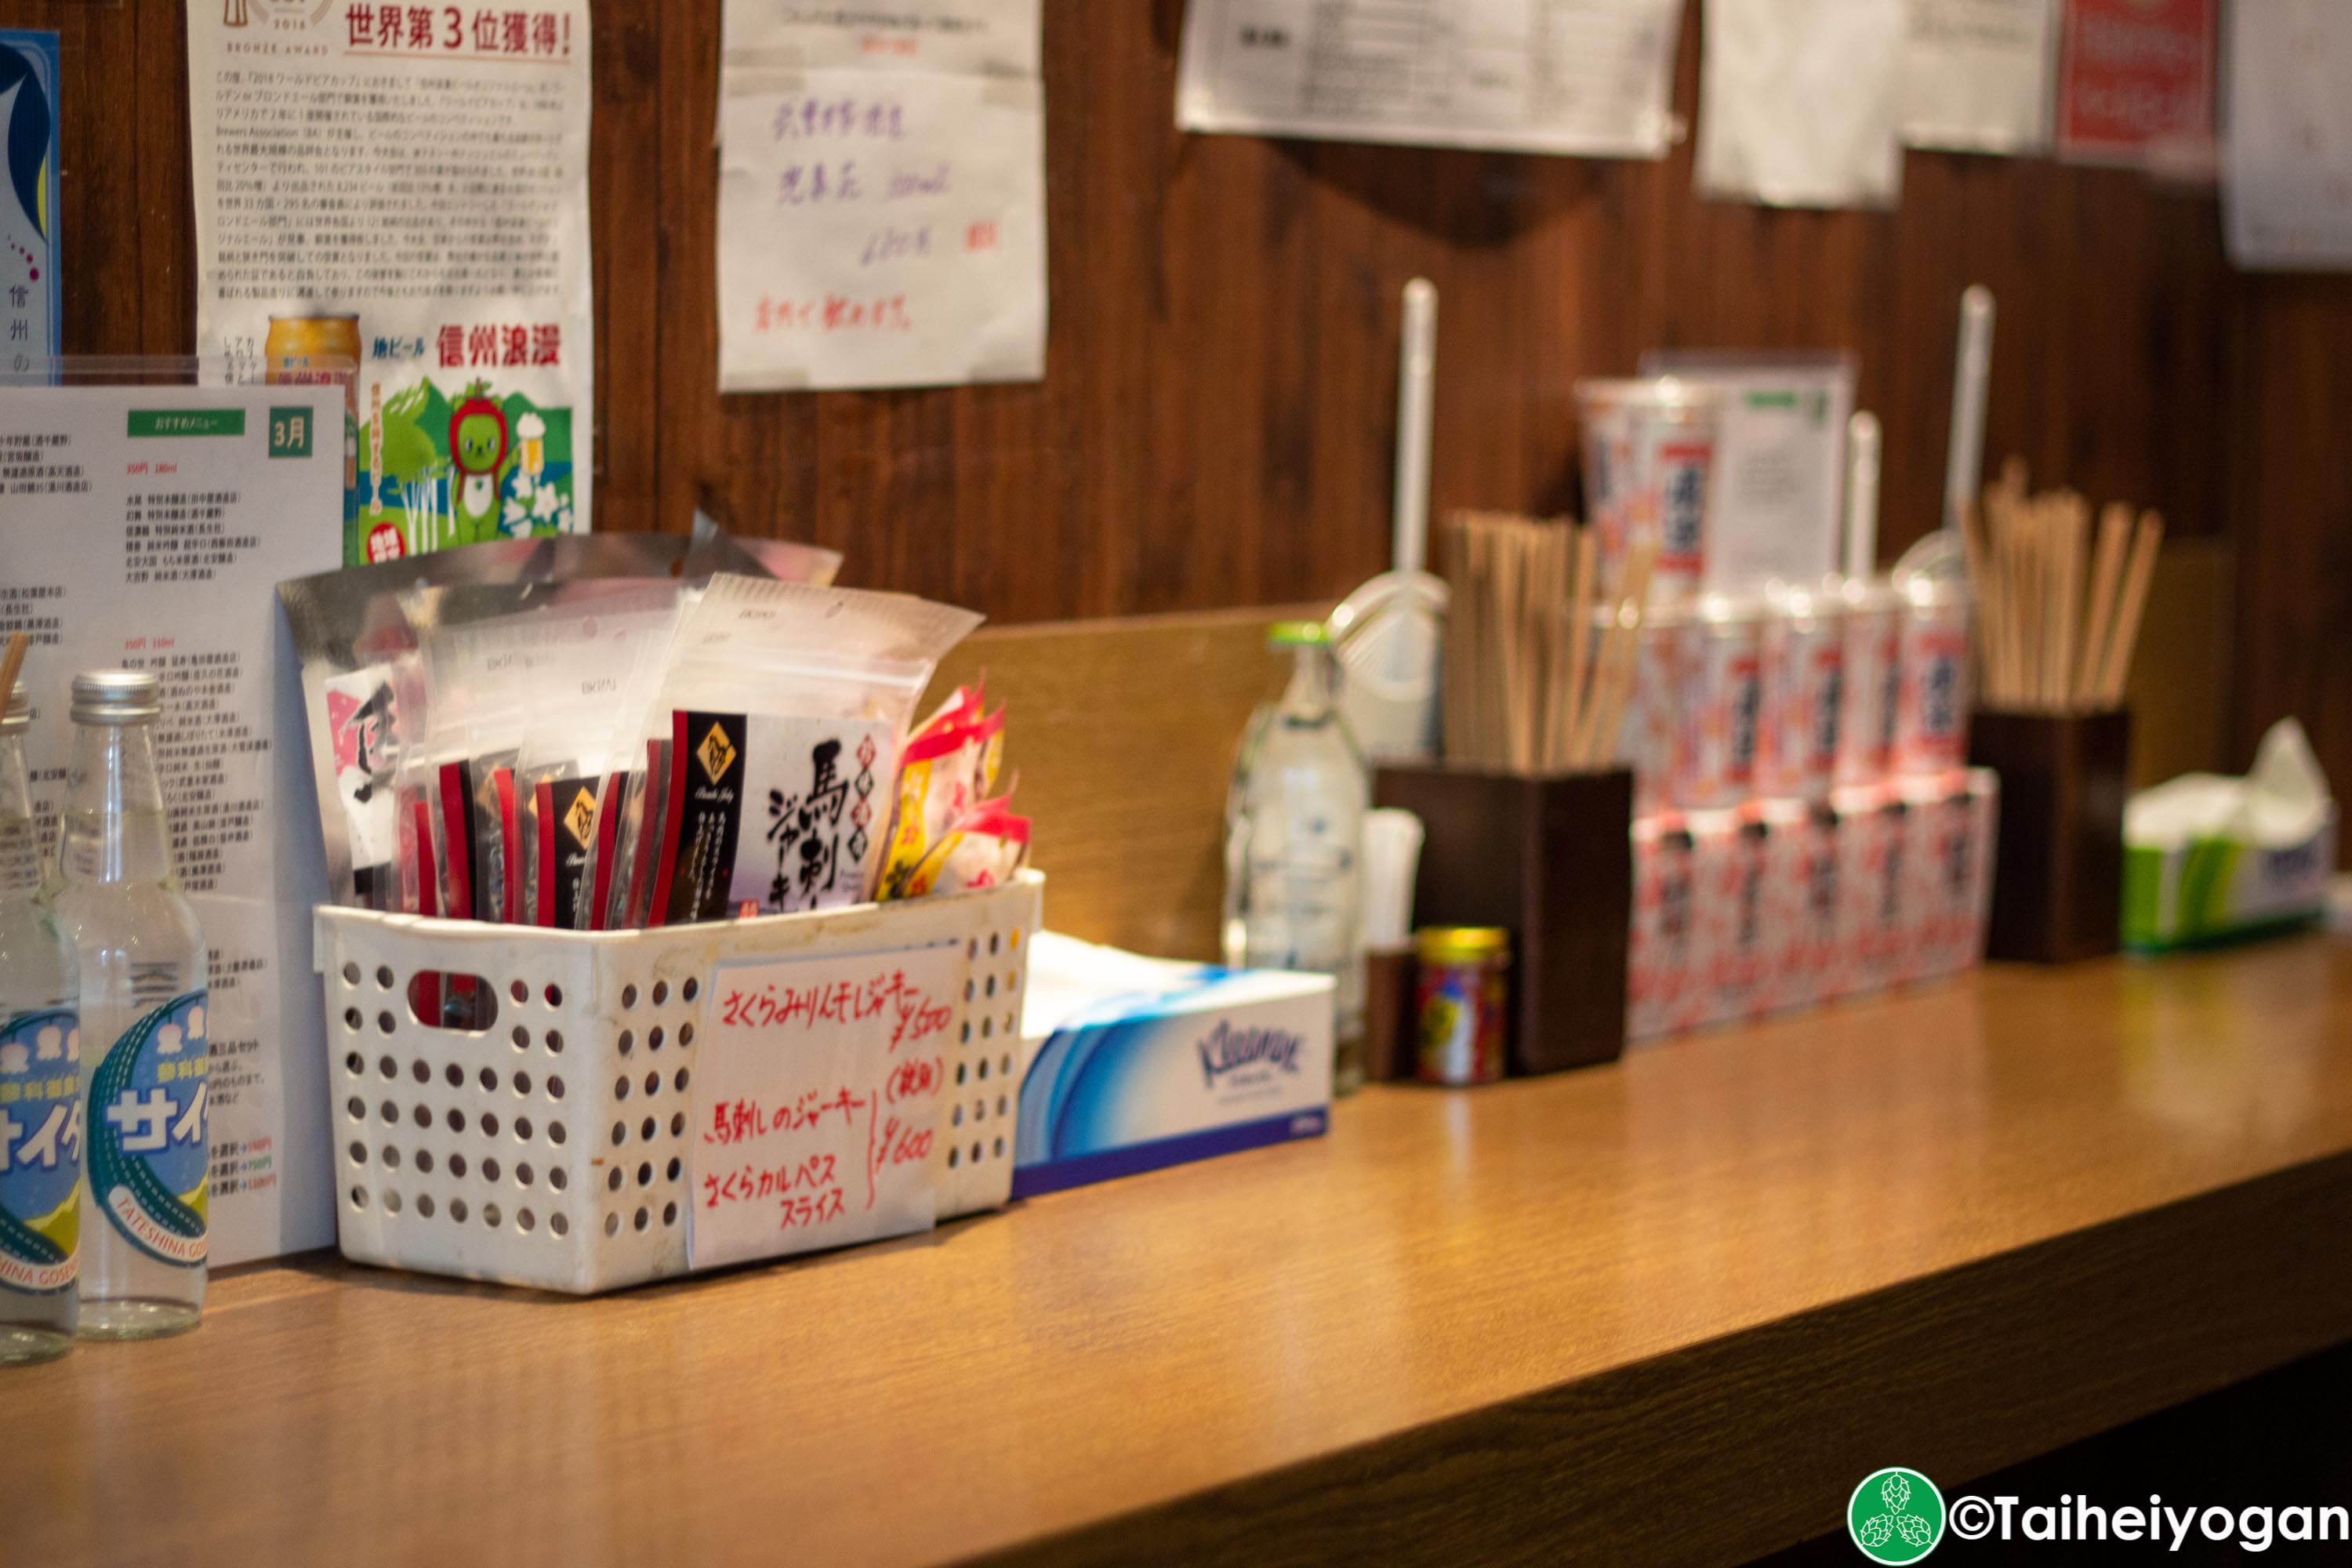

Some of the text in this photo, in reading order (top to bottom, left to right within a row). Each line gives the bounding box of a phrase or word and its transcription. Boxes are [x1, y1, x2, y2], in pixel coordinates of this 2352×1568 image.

[346, 2, 571, 55] 世界第3位獲得!
[372, 336, 425, 360] 地ビール
[436, 322, 561, 368] 信州浪漫
[274, 416, 305, 449] 3月
[107, 1081, 209, 1152] サイ
[704, 1154, 837, 1208] さくらカルパス
[118, 1195, 186, 1257] TATESHINA
[780, 1189, 845, 1230] スライス
